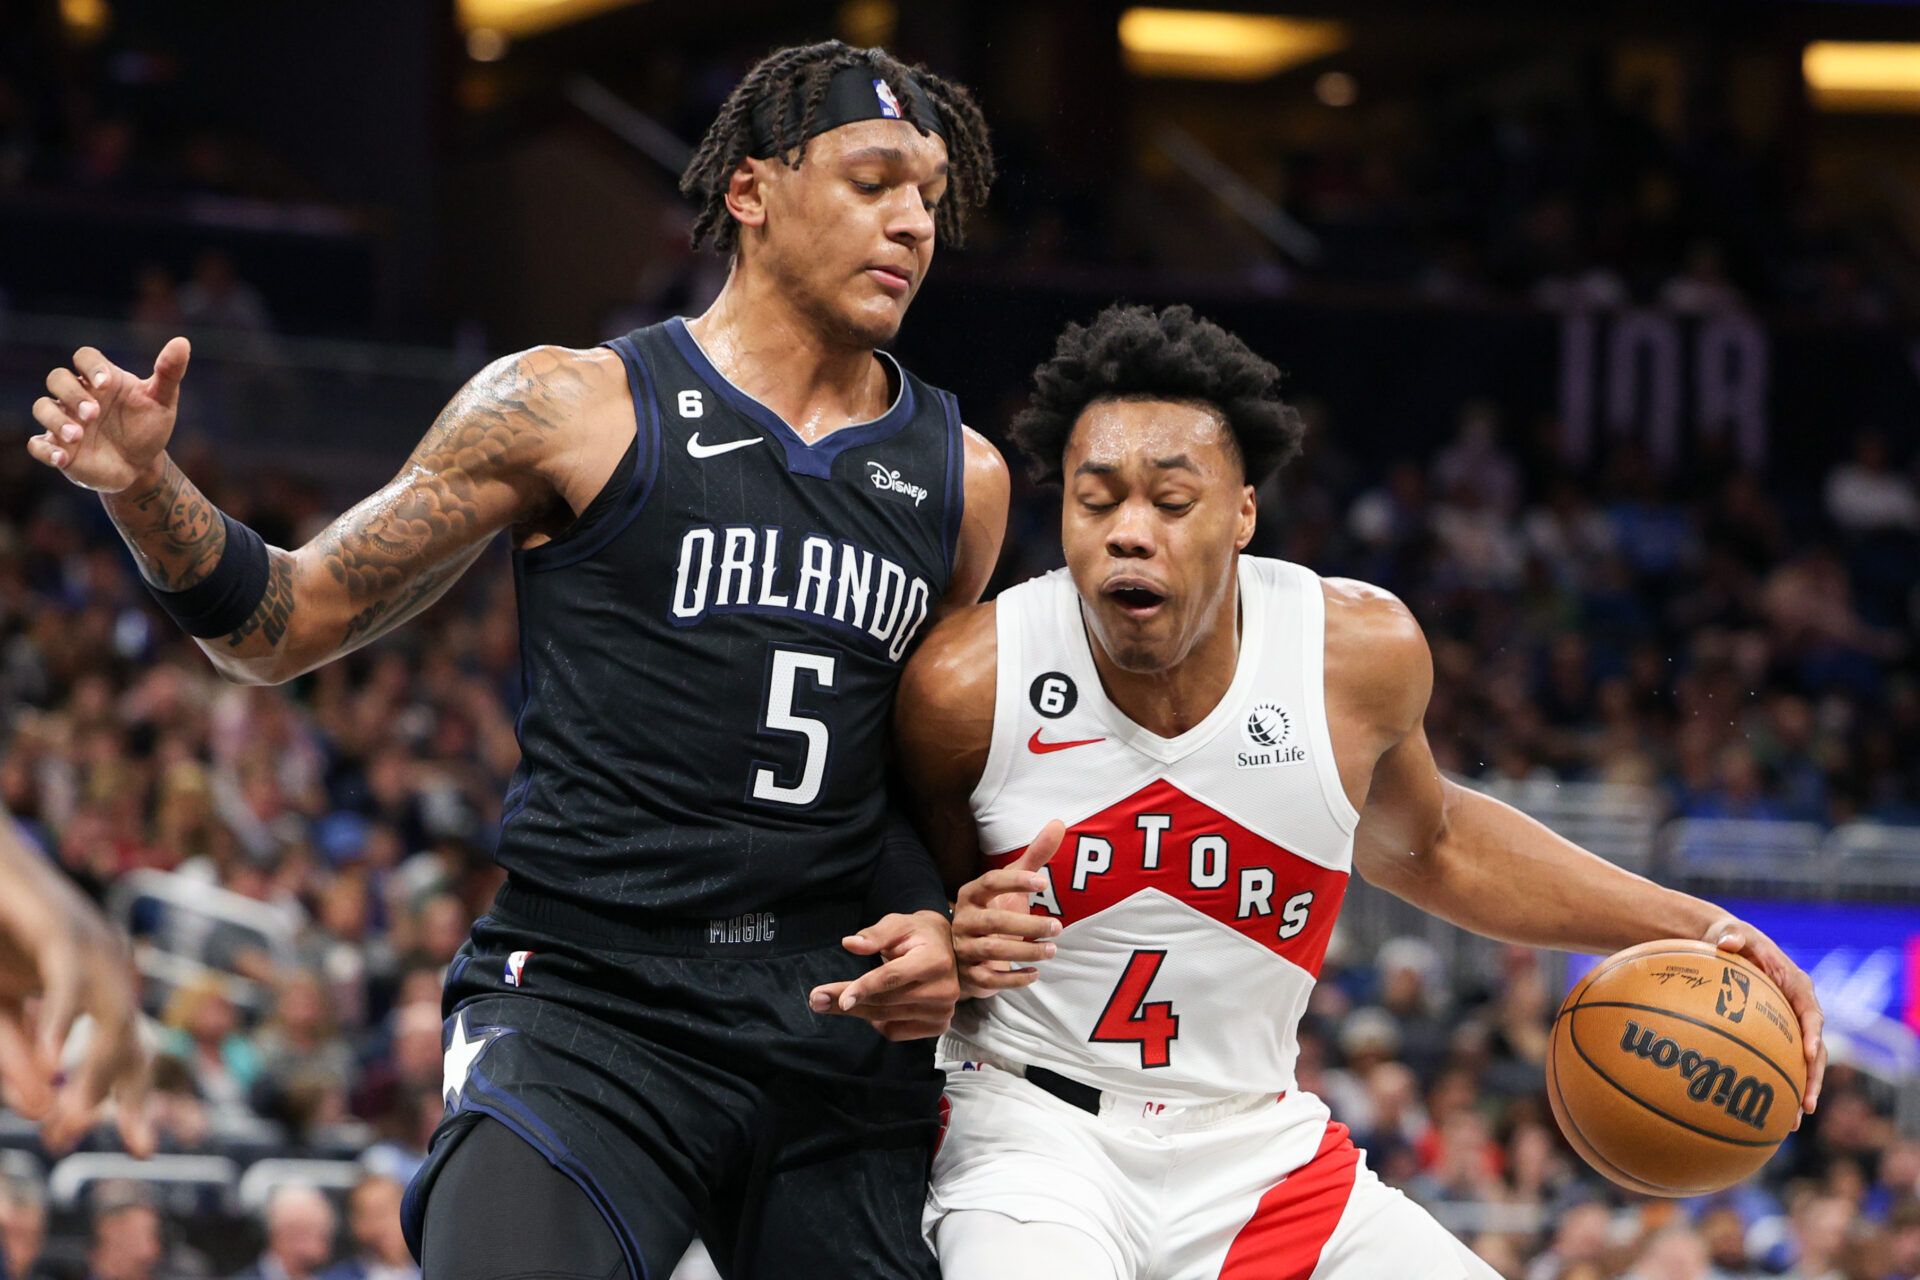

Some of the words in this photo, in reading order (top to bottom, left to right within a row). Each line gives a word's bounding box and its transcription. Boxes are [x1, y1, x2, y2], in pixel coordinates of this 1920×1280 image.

[677, 390, 703, 418] 6
[867, 461, 928, 507] Disney
[671, 526, 930, 663] ORLANDO
[752, 649, 836, 805] 5
[1039, 678, 1068, 714] 6
[1237, 752, 1271, 767] Sun
[1275, 745, 1305, 763] Life
[1028, 813, 1314, 941] APTORS
[708, 911, 777, 944] MAGIC
[1088, 949, 1180, 1070] 4
[1620, 1019, 1776, 1131] Wilson
